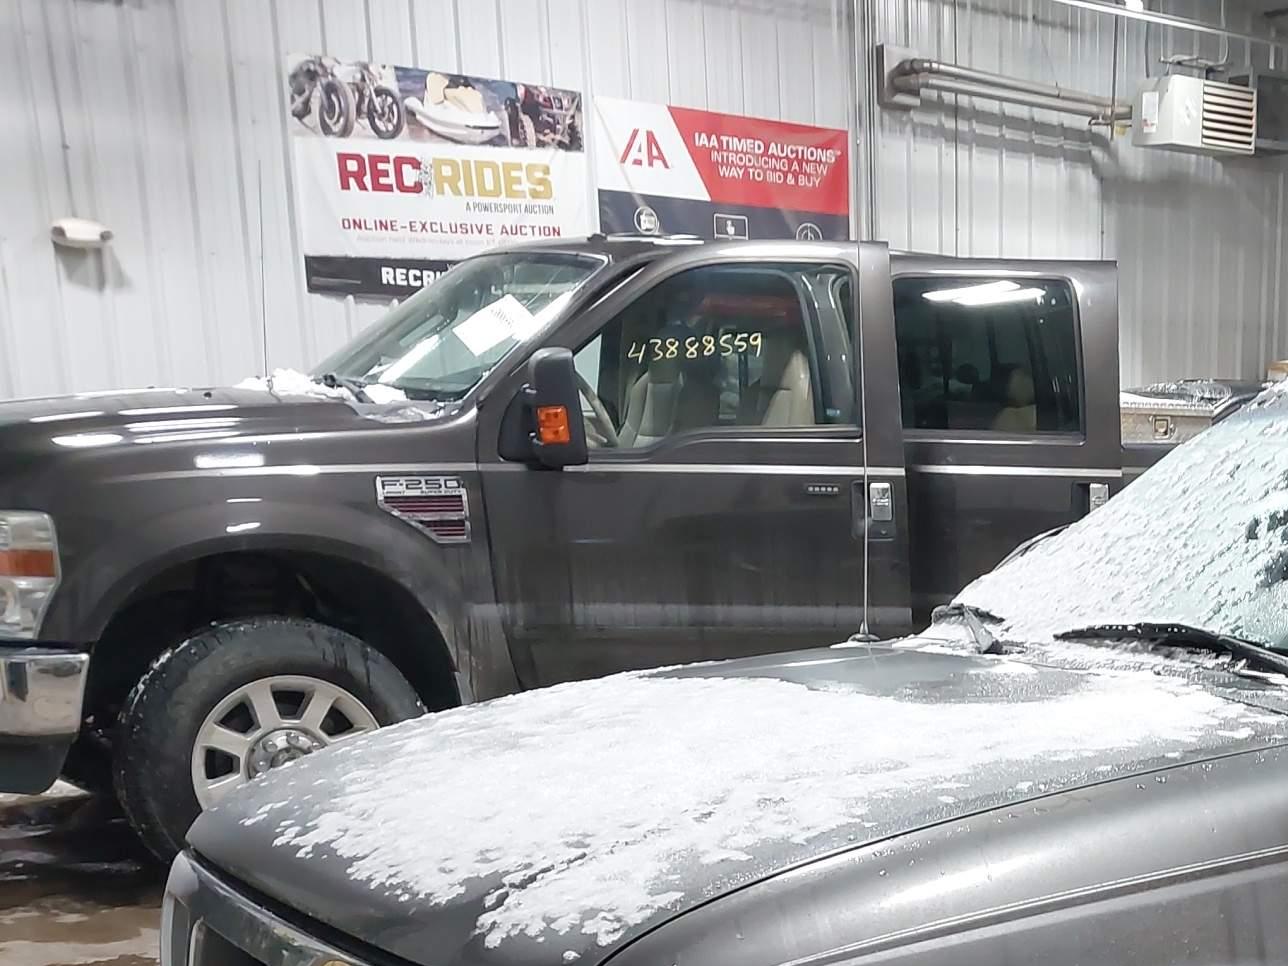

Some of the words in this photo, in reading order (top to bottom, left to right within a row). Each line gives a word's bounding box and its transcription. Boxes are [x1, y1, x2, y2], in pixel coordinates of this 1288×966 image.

[695, 132, 718, 149] IAA
[720, 135, 764, 154] TIMED
[711, 150, 788, 171] INTRODUCING
[790, 161, 799, 172] A
[802, 162, 828, 176] NEW
[336, 152, 424, 193] REC
[432, 157, 553, 199] RIDES
[718, 165, 744, 179] WAY
[748, 168, 763, 181] TO
[766, 170, 783, 184] BID
[786, 173, 795, 185] &
[798, 174, 821, 188] BUY
[465, 201, 472, 212] A
[473, 202, 522, 214] POWERSPORT
[524, 203, 554, 215] AUCTION
[341, 217, 494, 236] ONLINE-EXCLUSIVE
[500, 223, 561, 237] AUCTION
